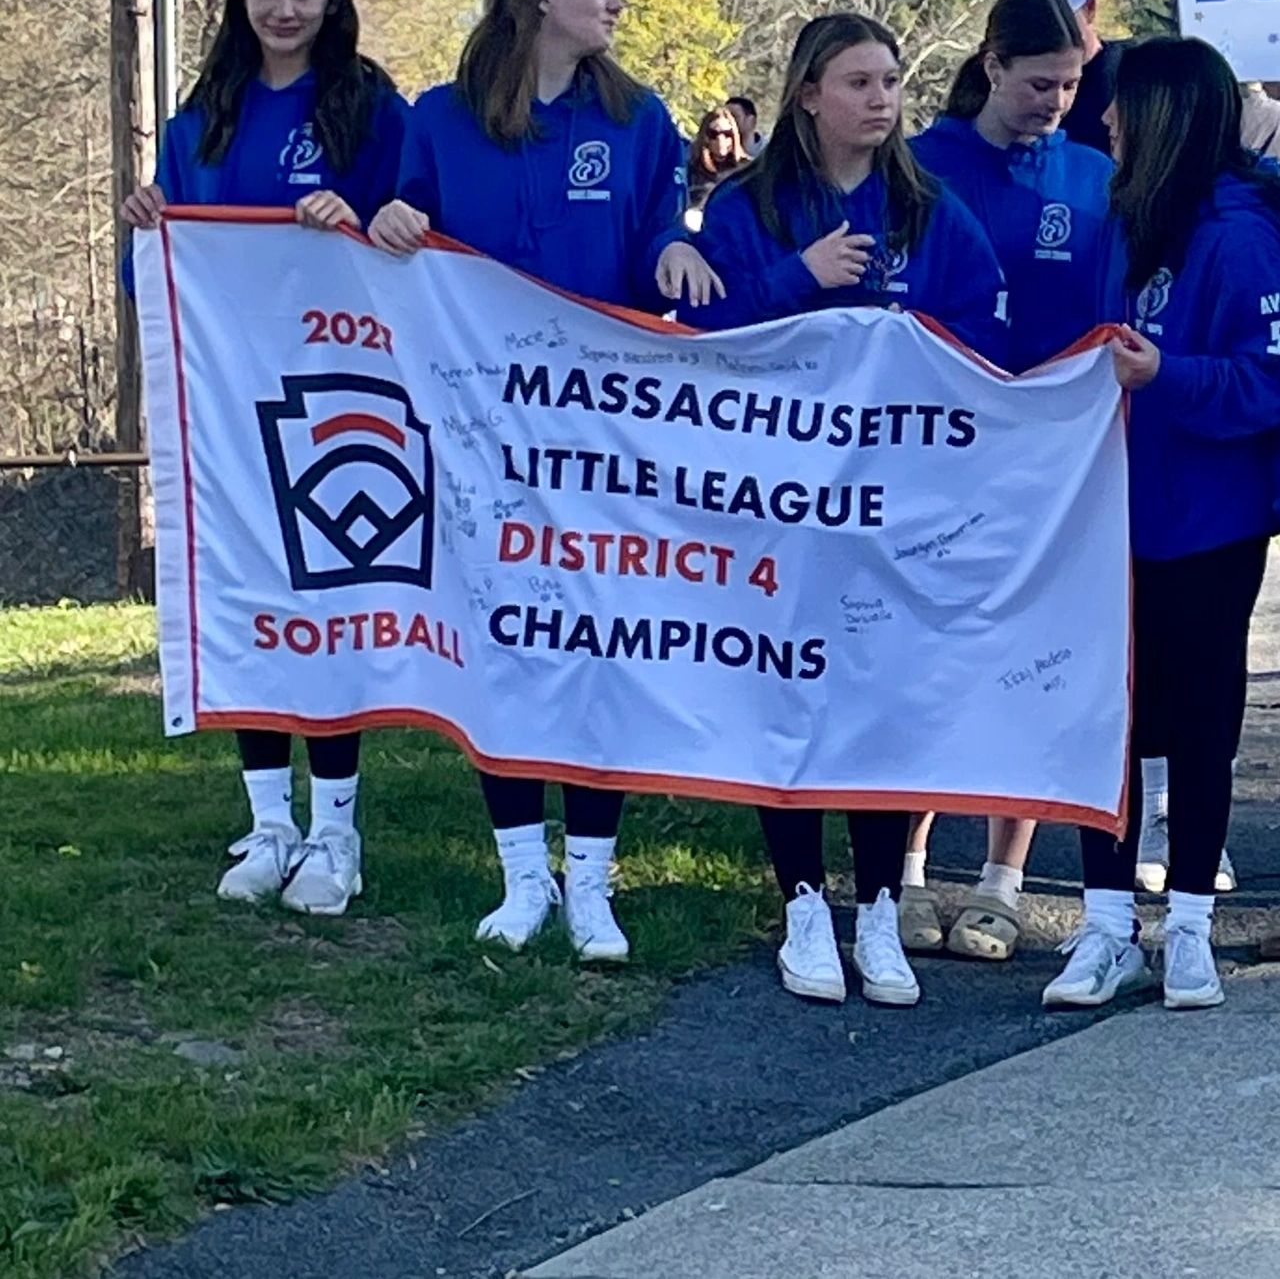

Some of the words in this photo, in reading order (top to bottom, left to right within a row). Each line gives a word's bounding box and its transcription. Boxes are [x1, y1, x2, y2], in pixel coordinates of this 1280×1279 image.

[502, 363, 976, 448] MASSACHUSETTS
[501, 444, 658, 500] LITTLE
[675, 466, 884, 527] LEAGUE
[499, 522, 734, 585] DISTRICT
[748, 557, 779, 597] 4
[253, 610, 465, 669] SOFTBALL
[489, 604, 826, 679] CHAMPIONS
